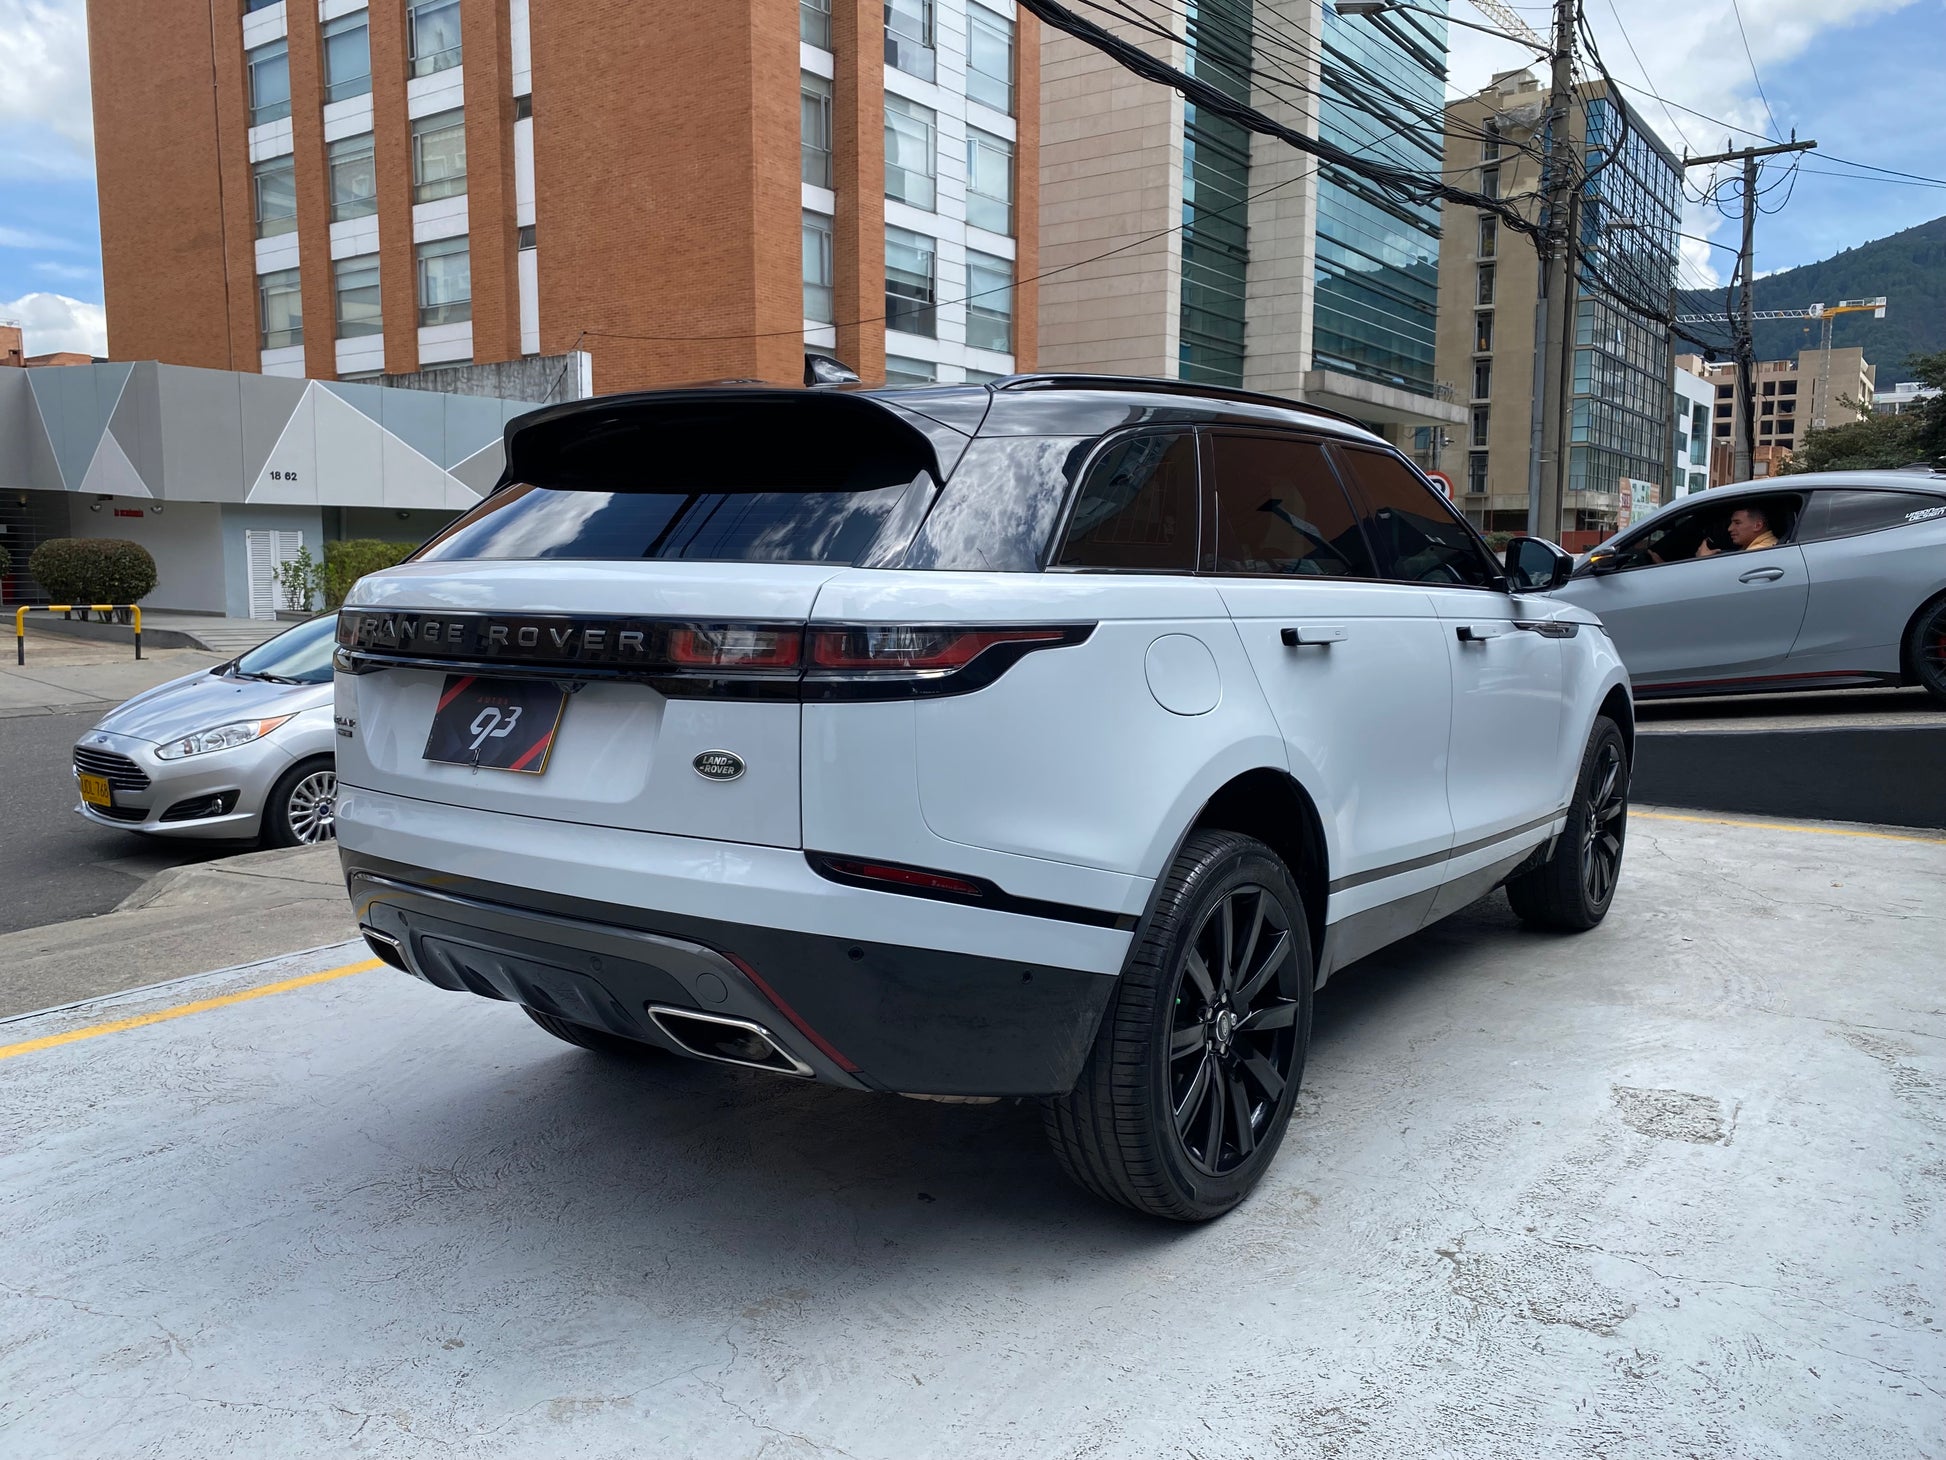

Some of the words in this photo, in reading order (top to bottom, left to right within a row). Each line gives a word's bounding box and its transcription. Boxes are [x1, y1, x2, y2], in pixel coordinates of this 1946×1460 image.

[270, 471, 281, 480] 18
[285, 471, 297, 481] 62
[361, 618, 465, 644] RANGE
[488, 625, 645, 653] ROVER
[702, 755, 728, 766] LAND
[704, 764, 735, 775] ROVER
